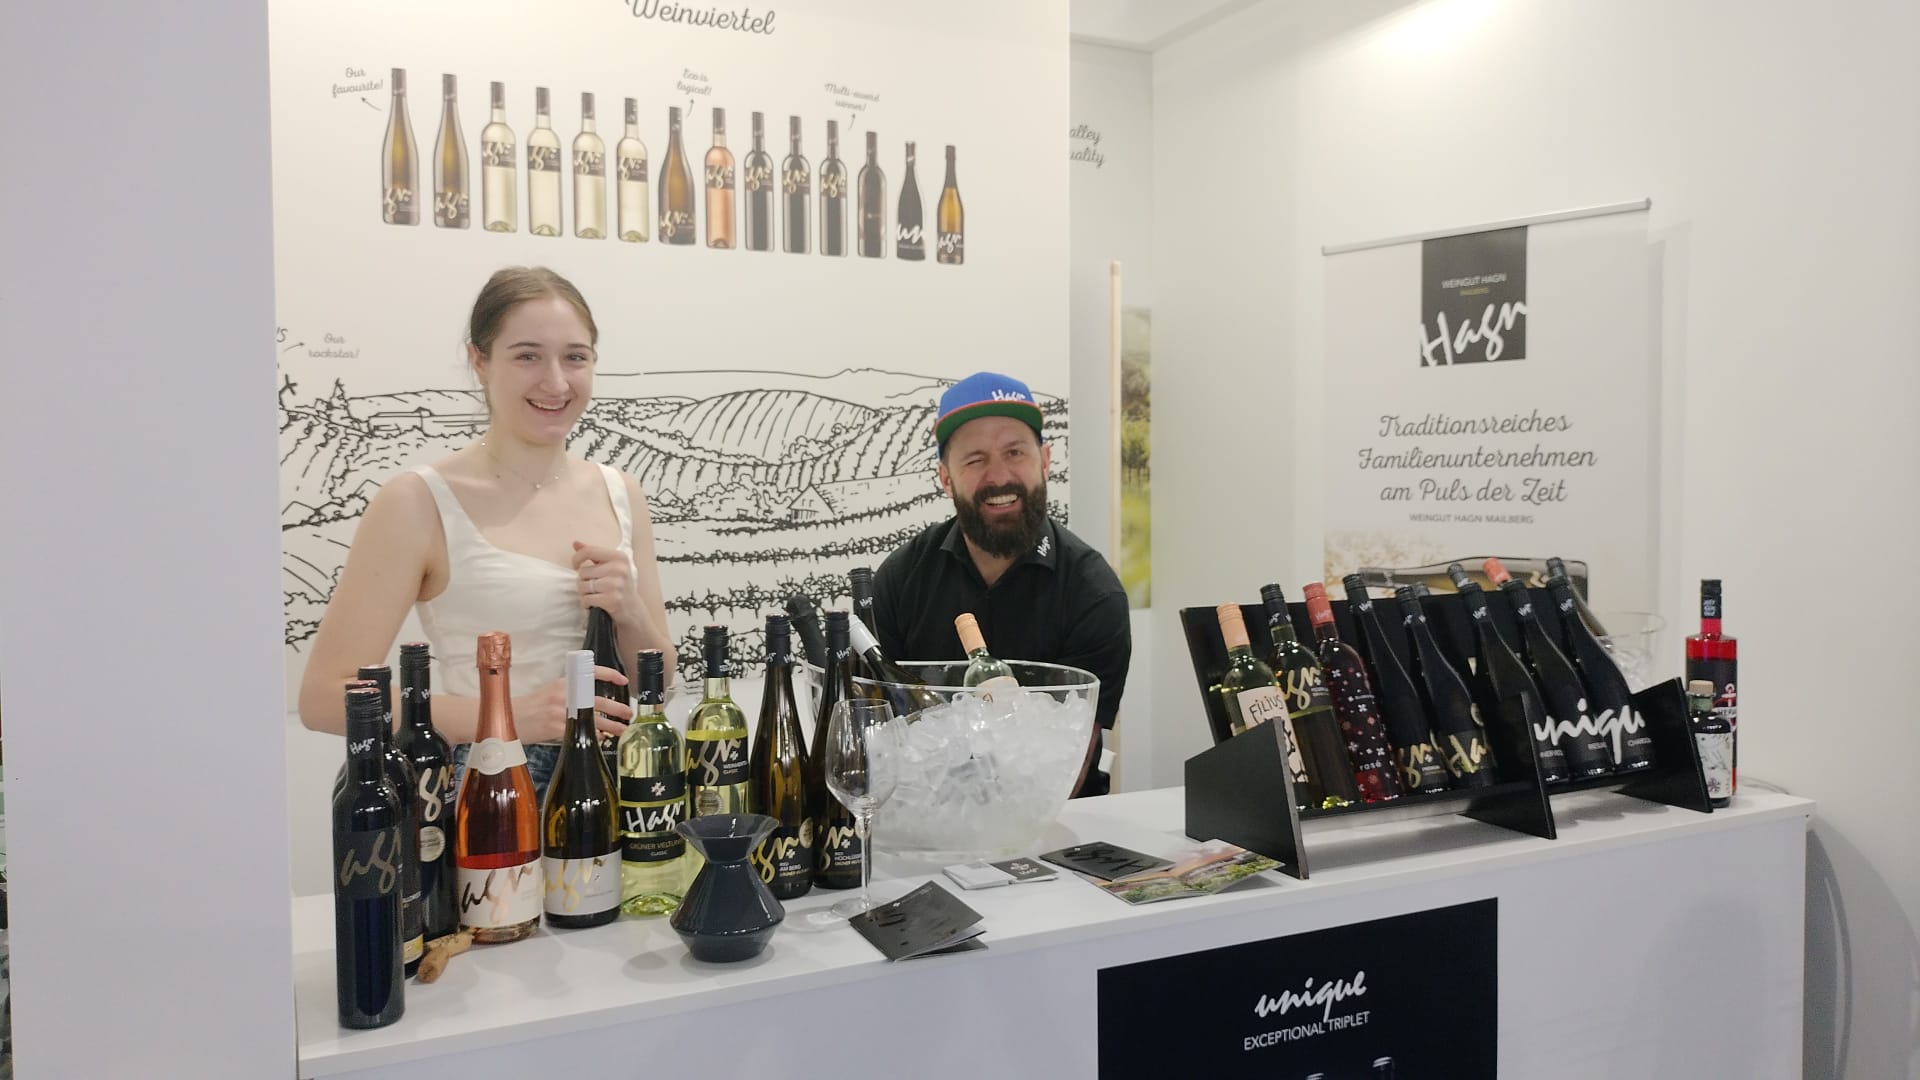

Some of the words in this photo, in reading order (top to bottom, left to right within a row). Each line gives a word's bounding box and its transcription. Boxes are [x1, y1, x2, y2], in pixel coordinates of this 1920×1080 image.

[624, 0, 775, 35] Weinviertel
[345, 66, 367, 79] Our
[1420, 300, 1527, 366] Hagn
[1379, 409, 1573, 437] Traditionsreiches
[1358, 444, 1599, 470] Familienunternehmen
[1380, 485, 1413, 502] am
[1419, 477, 1473, 502] Puls
[1476, 478, 1516, 502] der
[1521, 477, 1570, 506] Zeit
[1409, 513, 1451, 523] WEINGUT
[1454, 514, 1483, 523] HAGN
[1486, 515, 1535, 525] MAILBERG
[350, 738, 375, 755] Hagn
[625, 800, 685, 833] Hagn
[1254, 970, 1368, 1023] unique
[1243, 1021, 1326, 1051] EXCEPTIONAL
[1326, 1010, 1371, 1032] TRIPLET
